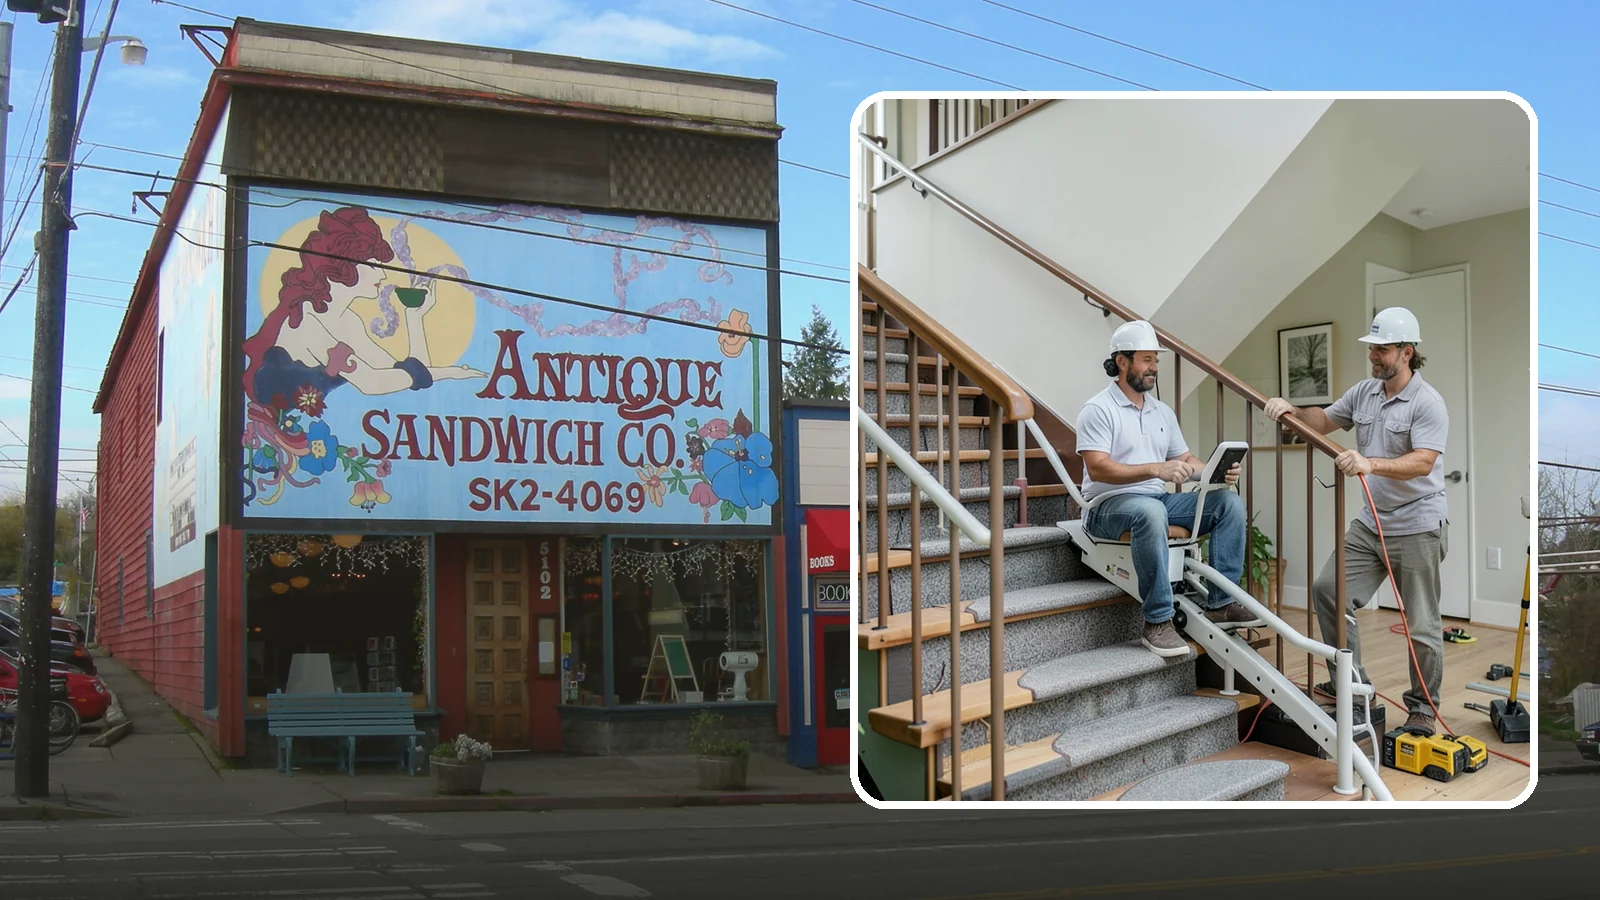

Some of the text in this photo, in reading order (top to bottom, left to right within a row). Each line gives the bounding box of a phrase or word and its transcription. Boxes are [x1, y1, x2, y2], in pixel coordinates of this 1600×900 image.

[475, 329, 723, 421] ANTIQUE
[361, 408, 685, 468] SANDWICH CO.
[468, 477, 645, 513] SK2-4069
[539, 541, 552, 600] 5102
[809, 555, 835, 568] BOOKS
